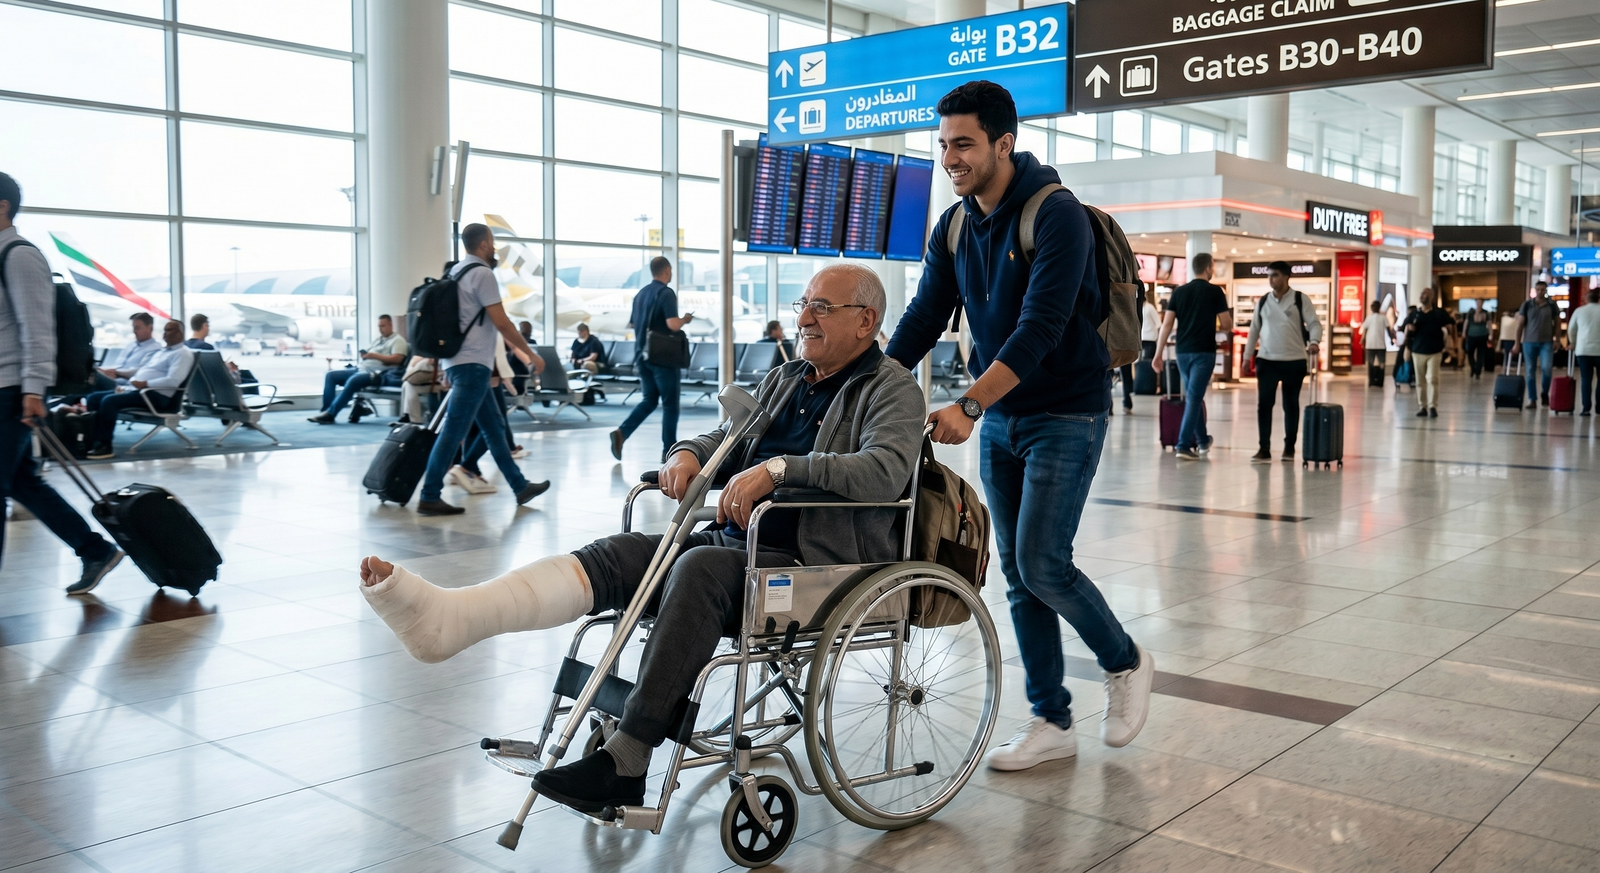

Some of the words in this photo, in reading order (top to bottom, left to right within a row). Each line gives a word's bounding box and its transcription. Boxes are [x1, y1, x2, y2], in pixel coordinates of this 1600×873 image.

[1172, 6, 1264, 33] BAGGAGE
[1271, 0, 1335, 17] CLAIM
[948, 47, 986, 67] GATE
[996, 17, 1059, 57] B32
[950, 25, 986, 47] بوابة
[1183, 53, 1269, 83] Gates
[1280, 26, 1423, 72] B30-B40
[846, 85, 916, 114] المغادرون
[845, 106, 935, 130] DEPARTURES
[1313, 206, 1343, 233] DUTY
[1343, 213, 1368, 237] FREE
[1439, 250, 1484, 262] COFFEE
[1485, 250, 1519, 262] SHOP
